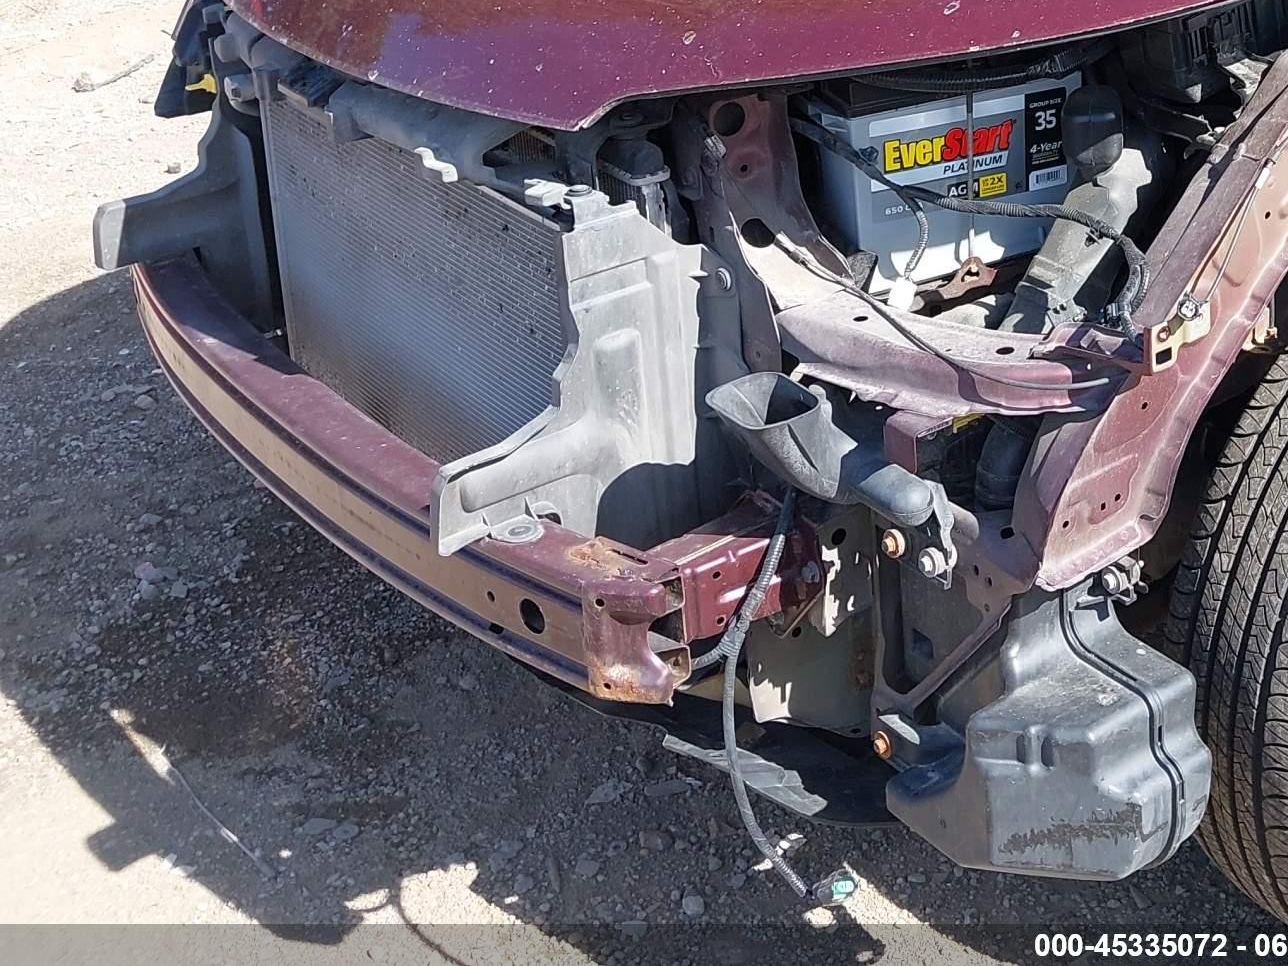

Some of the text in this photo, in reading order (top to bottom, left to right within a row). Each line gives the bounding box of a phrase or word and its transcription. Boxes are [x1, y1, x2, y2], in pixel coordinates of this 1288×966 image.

[1035, 109, 1057, 130] 35
[1030, 140, 1063, 153] 4-Year
[885, 205, 904, 215] 650
